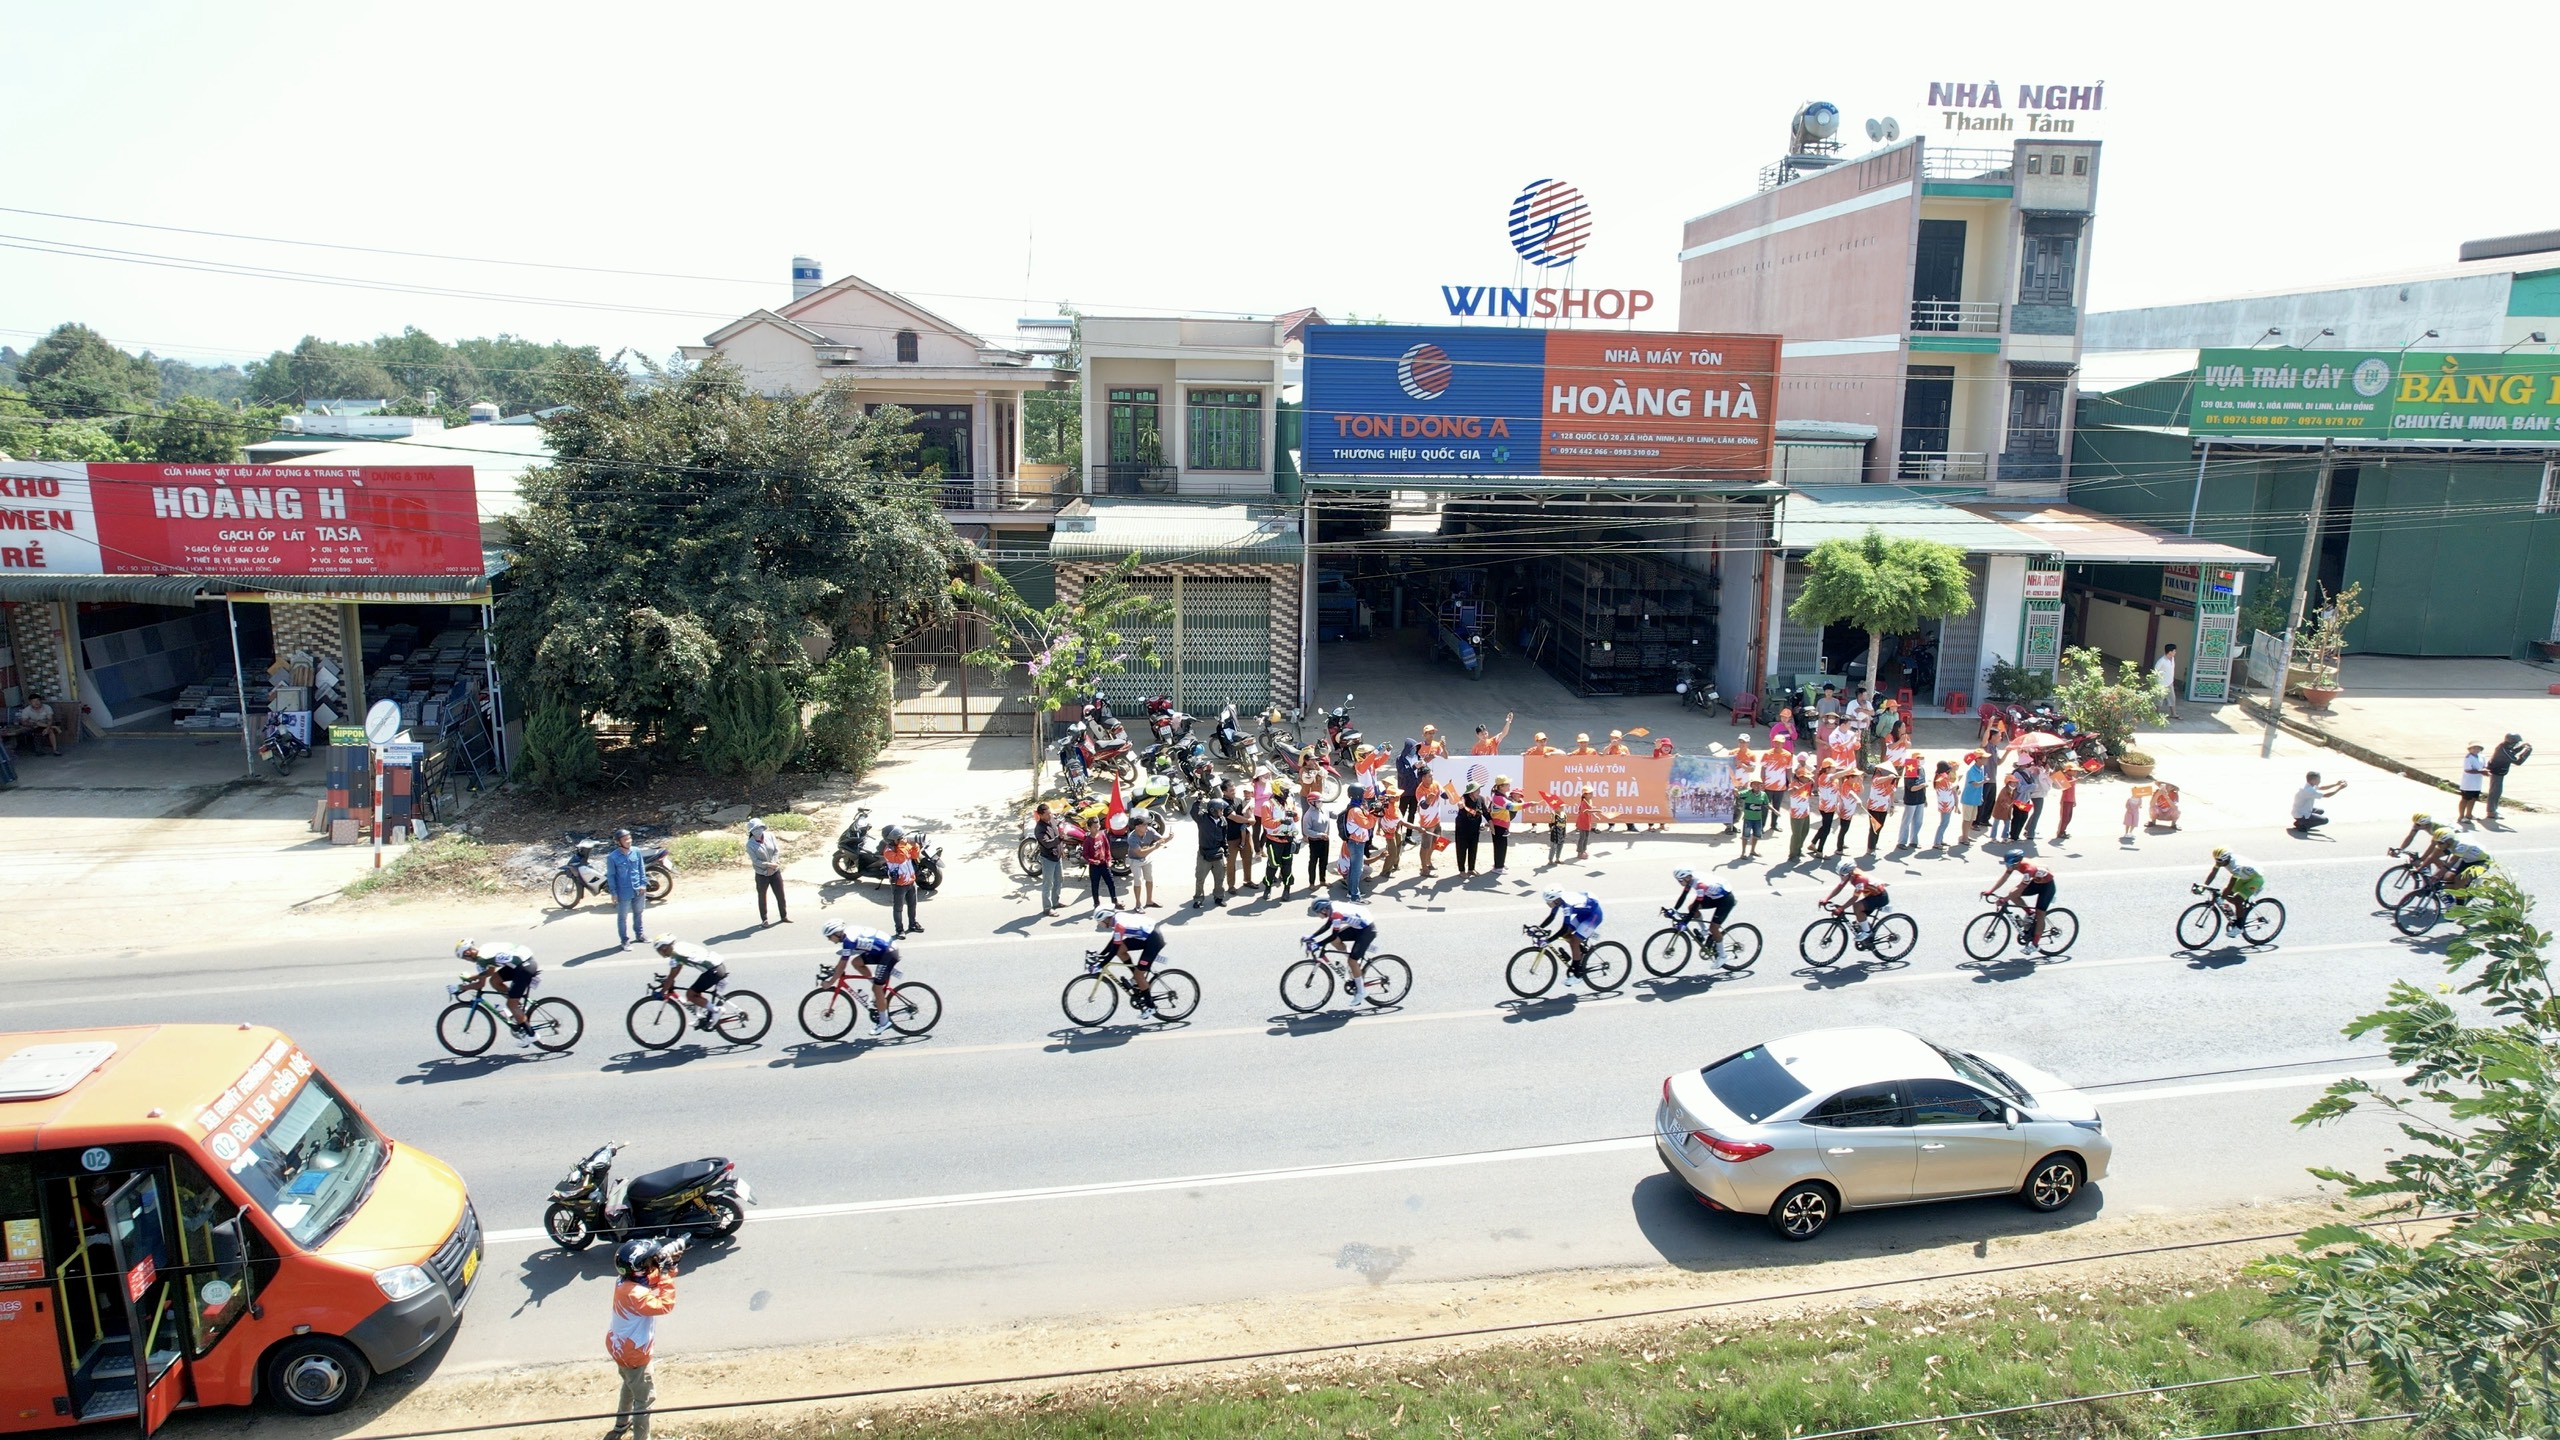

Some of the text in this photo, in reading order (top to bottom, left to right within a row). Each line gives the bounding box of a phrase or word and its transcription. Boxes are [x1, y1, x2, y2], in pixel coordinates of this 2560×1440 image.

[1928, 80, 2105, 110] NHÀ NGHỈ
[1942, 112, 2075, 132] Thanh Tâm
[1441, 285, 1654, 319] WINSHOP
[1605, 347, 1722, 365] NHÀ MÁY TÔN
[2205, 364, 2244, 391] VỰA
[2252, 363, 2298, 389] TRÁI
[2302, 364, 2345, 389] CÂY
[1551, 379, 1759, 418] HOÀNG HÀ
[2200, 401, 2213, 409] 139
[2236, 401, 2256, 410] THÔN
[2266, 401, 2281, 410] HÒA
[2305, 402, 2314, 410] DI
[2315, 402, 2335, 411] LINH,
[2335, 402, 2352, 411] LÂM
[1334, 415, 1510, 438] TON DONG A
[2223, 415, 2247, 424] 0974
[2249, 415, 2268, 425] 589
[2270, 415, 2289, 425] 807
[2298, 415, 2322, 425] 0974
[2325, 416, 2344, 426] 979
[2346, 416, 2364, 426] 707
[2395, 412, 2464, 429] CHUYÊN
[2468, 415, 2507, 430] MUA
[2512, 412, 2550, 430] BÁN
[1560, 432, 1573, 440] 128
[1575, 431, 1597, 441] QUỐC
[1599, 432, 1609, 442] LỘ
[1611, 433, 1622, 442] 20,
[1624, 432, 1635, 441] XÃ
[1637, 433, 1653, 442] HÒA
[1656, 435, 1677, 443] NINH,
[1697, 436, 1716, 444] LINH,
[1717, 436, 1734, 444] LÂM
[1333, 446, 1480, 461] THƯƠNG HIỆU QUỐC GIA
[1560, 447, 1577, 455] 0974
[1579, 447, 1592, 455] 442
[1614, 448, 1631, 456] 0983
[164, 467, 182, 477] CỬA
[186, 467, 211, 477] HÀNG
[215, 467, 229, 478] VẬT
[234, 467, 252, 478] LIỆU
[276, 468, 301, 479] DỰNG
[304, 469, 311, 477] &
[313, 469, 344, 478] TRANG
[346, 467, 360, 477] TRÍ
[152, 479, 303, 519] HOÀNG
[0, 510, 74, 530] MEN
[219, 526, 362, 543] GẠCH ỐP LÁT TASA
[1, 540, 47, 568] RẺ
[191, 546, 210, 554] GẠCH
[213, 544, 222, 553] ỐP
[225, 545, 237, 553] LÁT
[256, 545, 269, 553] CẤP
[268, 556, 281, 564] CẤP
[339, 556, 353, 564] ỐNG
[333, 730, 365, 738] NIPPON
[1564, 763, 1626, 773] NHÀ MÁY TÔN
[1616, 777, 1639, 797] HÀ
[1637, 805, 1660, 814] ĐUA
[214, 1135, 237, 1158] 02
[229, 1113, 258, 1143] ĐÀ
[247, 1094, 275, 1124] LẠT
[85, 1151, 108, 1168] 02
